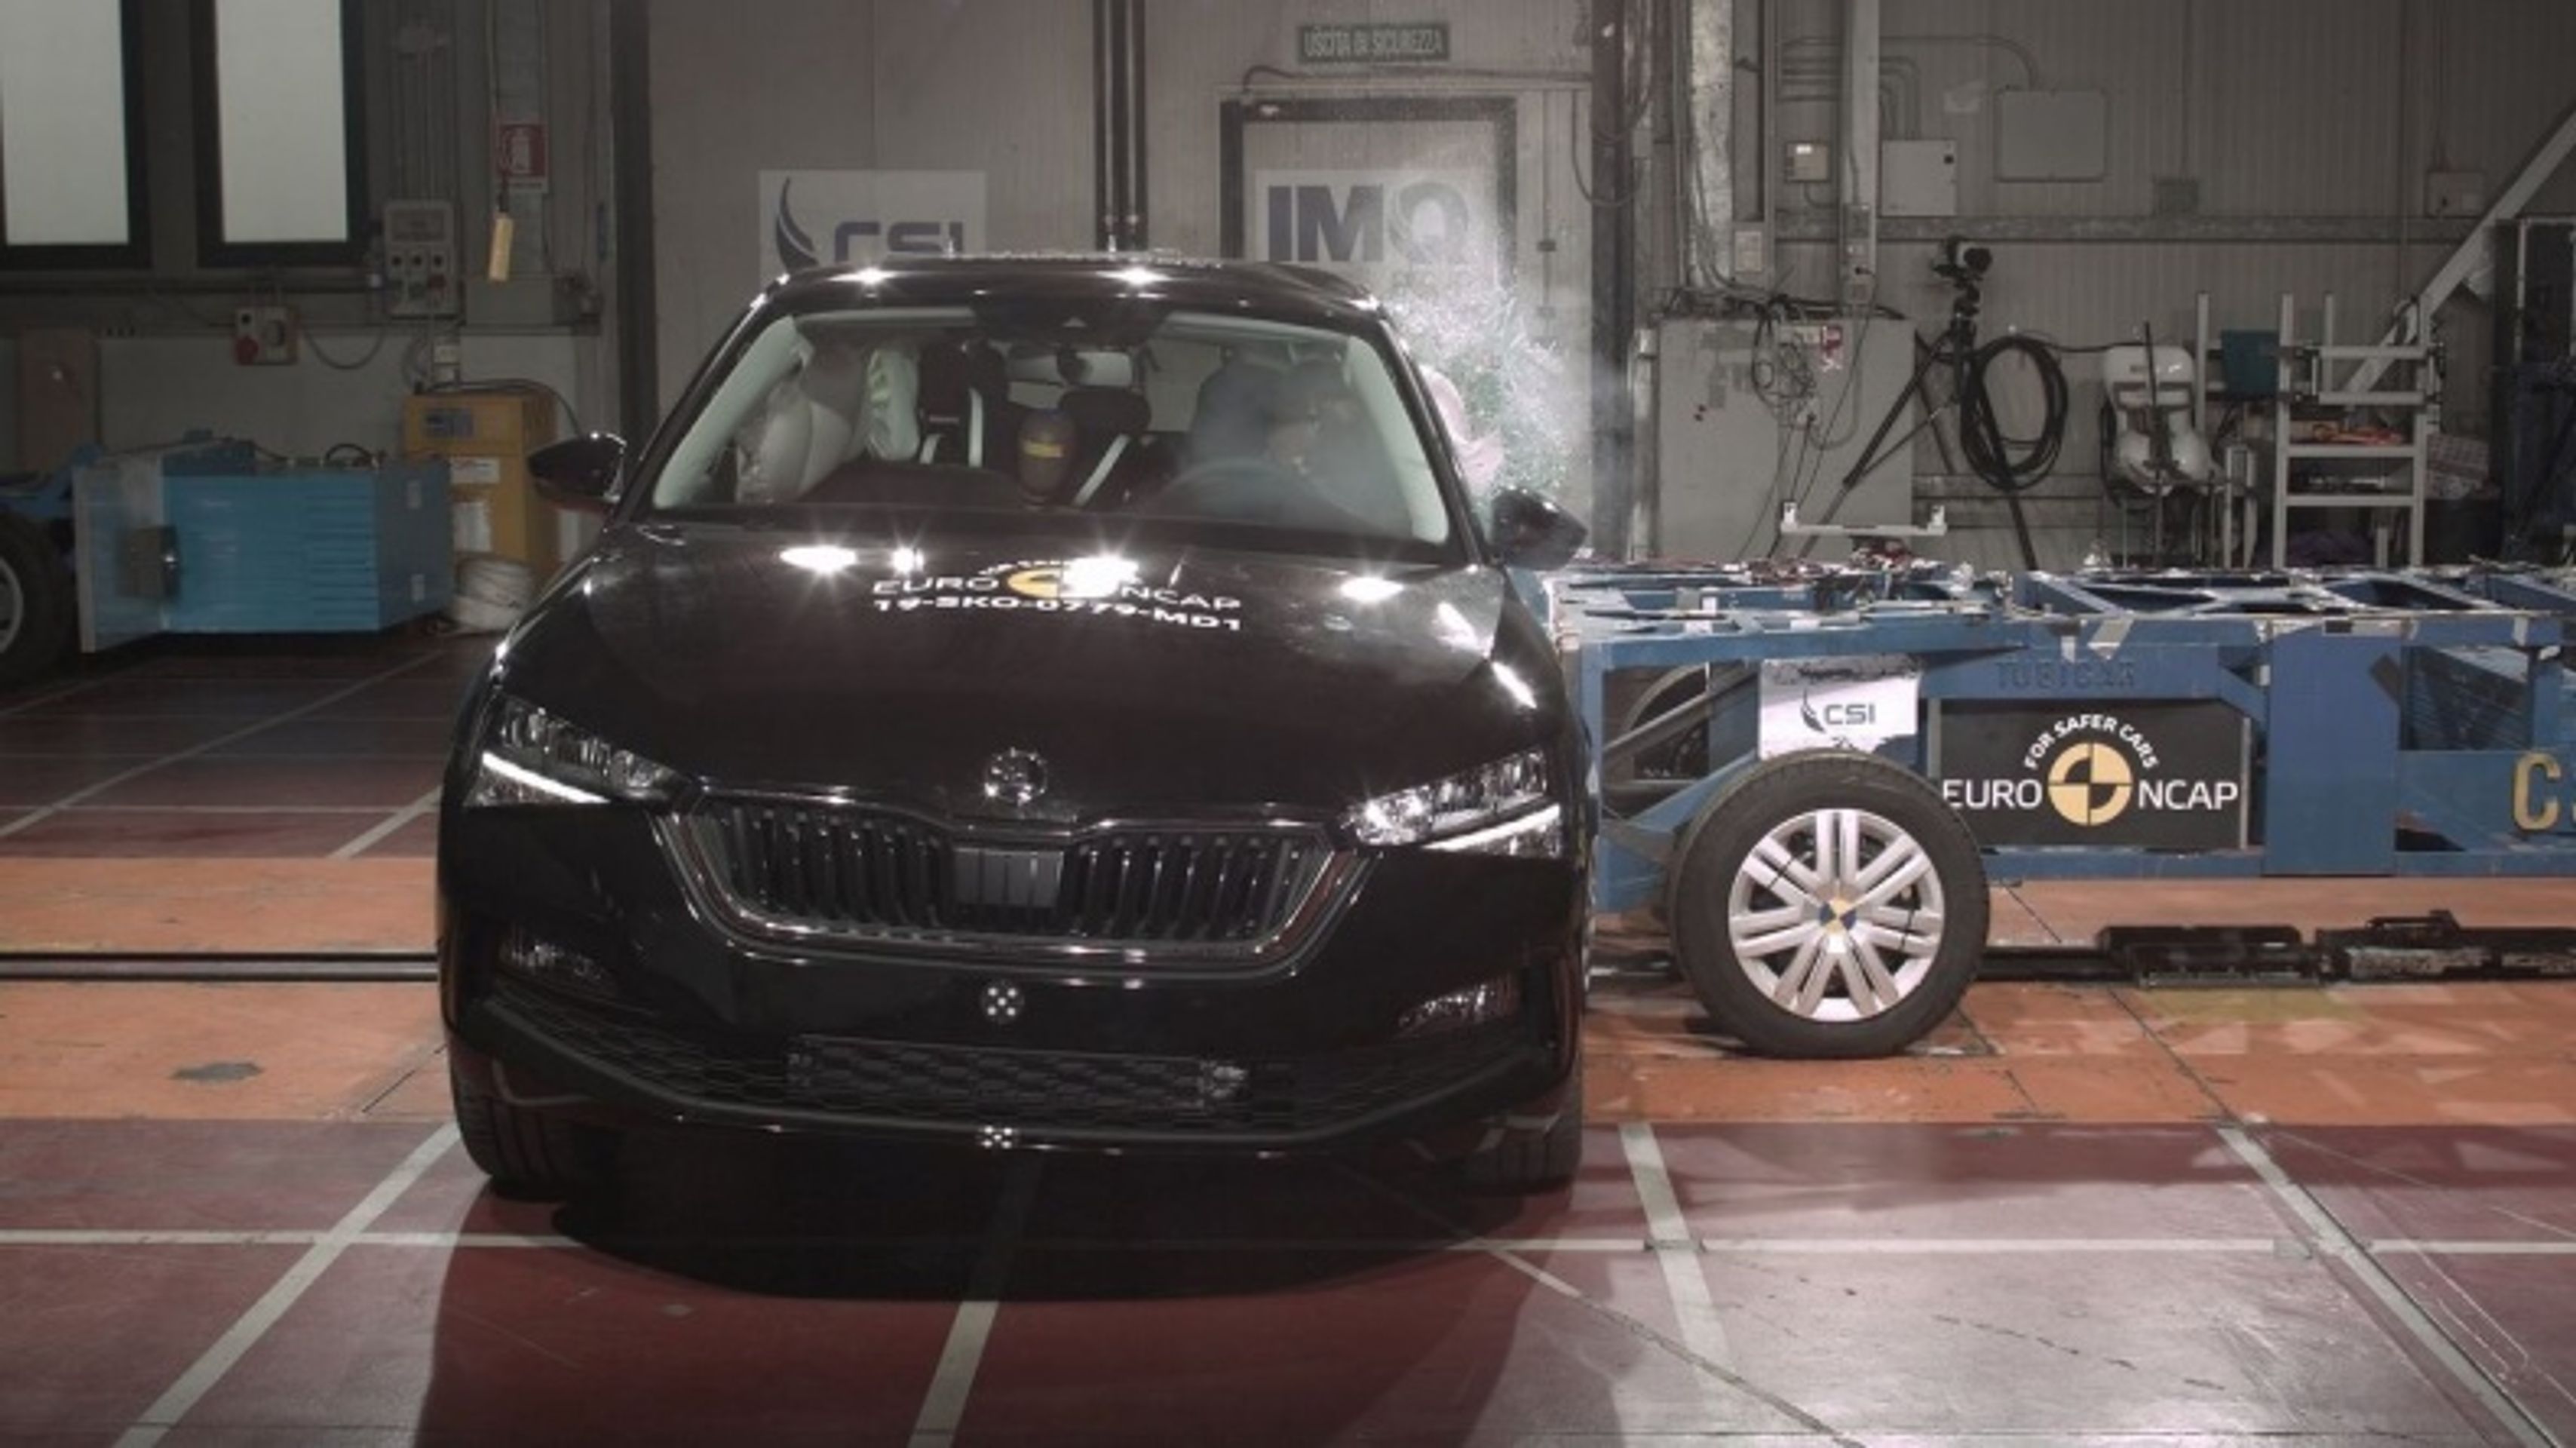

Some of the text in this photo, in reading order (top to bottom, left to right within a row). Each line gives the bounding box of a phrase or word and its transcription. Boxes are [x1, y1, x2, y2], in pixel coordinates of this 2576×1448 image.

[872, 577, 1241, 611] EURO NCAP
[1823, 704, 1875, 725] CSI
[2023, 713, 2160, 771] FOR SAFER CARS
[1942, 778, 2239, 810] EURO NCAP
